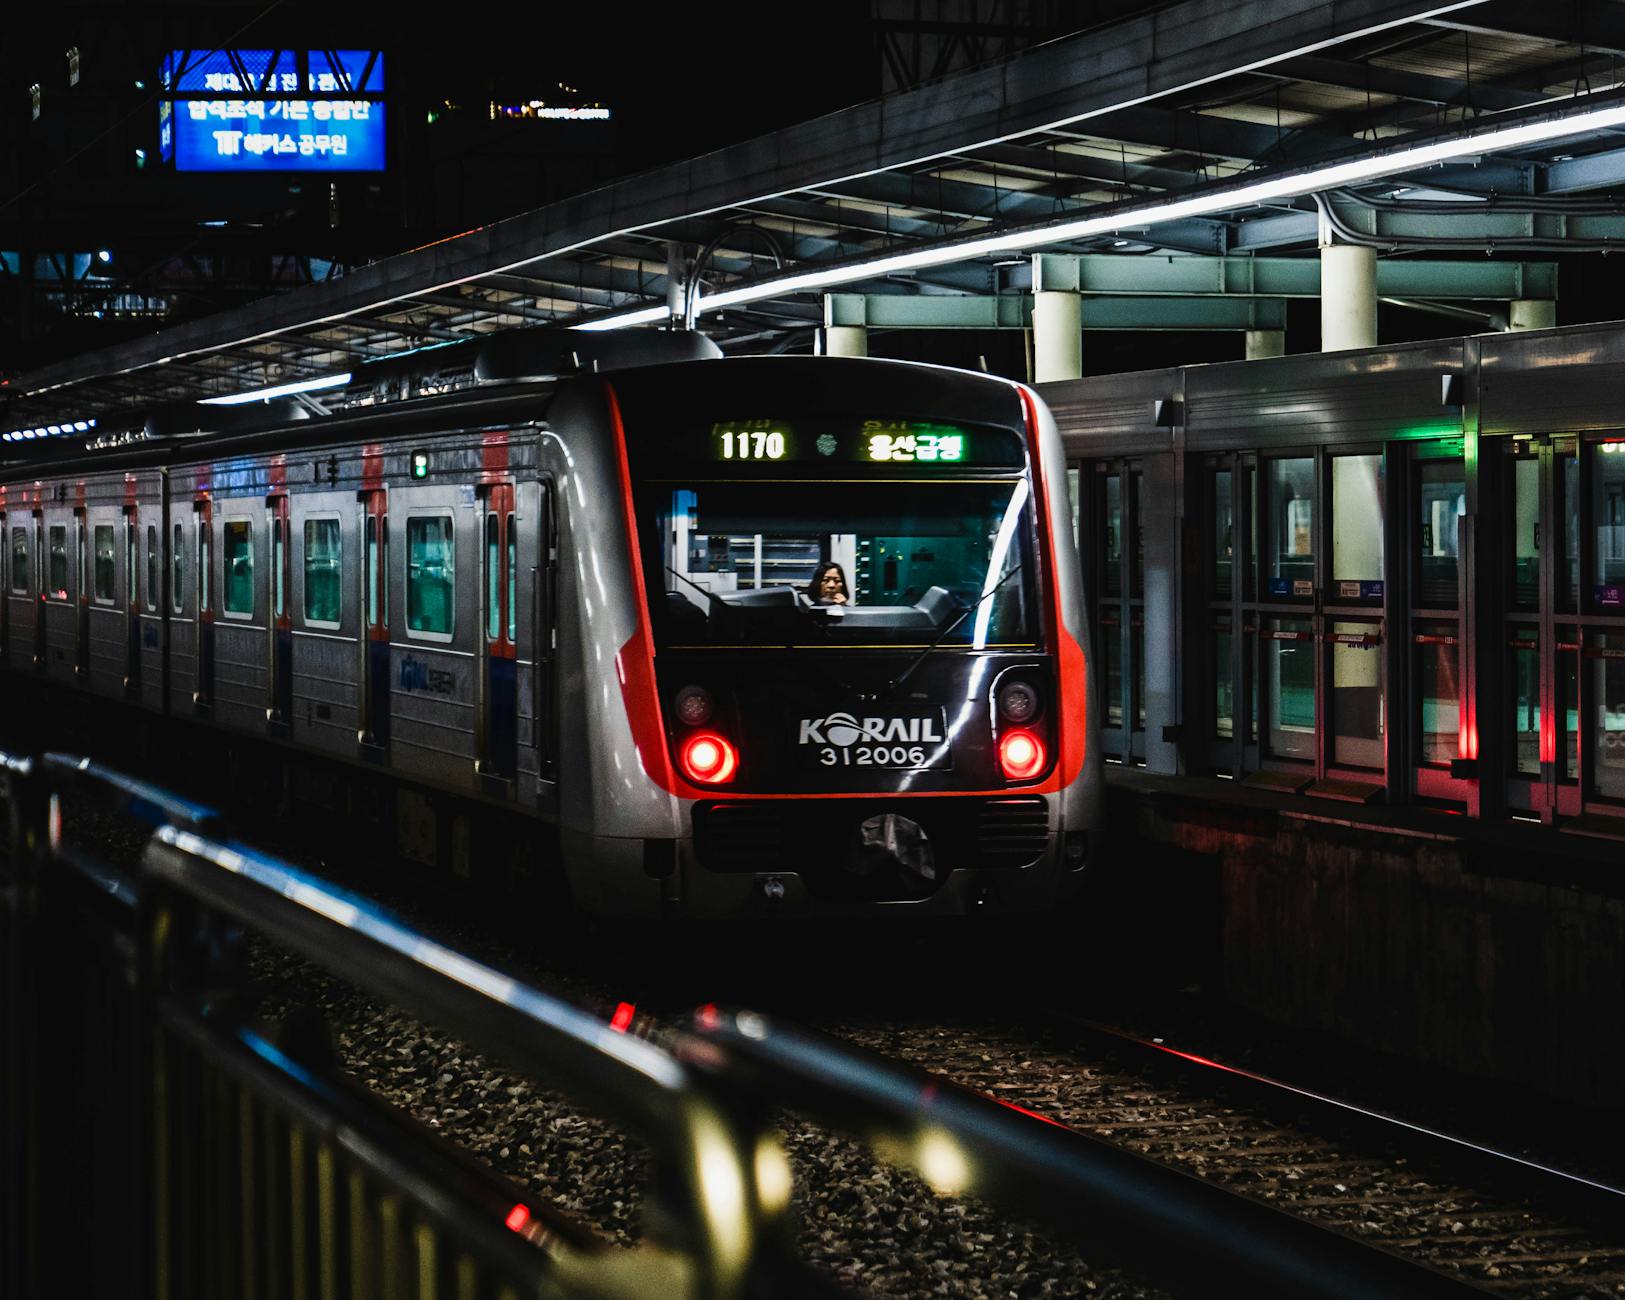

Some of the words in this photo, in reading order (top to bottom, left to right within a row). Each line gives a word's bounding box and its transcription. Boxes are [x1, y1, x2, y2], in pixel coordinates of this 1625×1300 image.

[298, 134, 347, 155] 공무원
[720, 431, 785, 459] 1170
[868, 434, 962, 461] 용산급행
[799, 712, 942, 747] KORAIL
[820, 746, 926, 766] 312006
